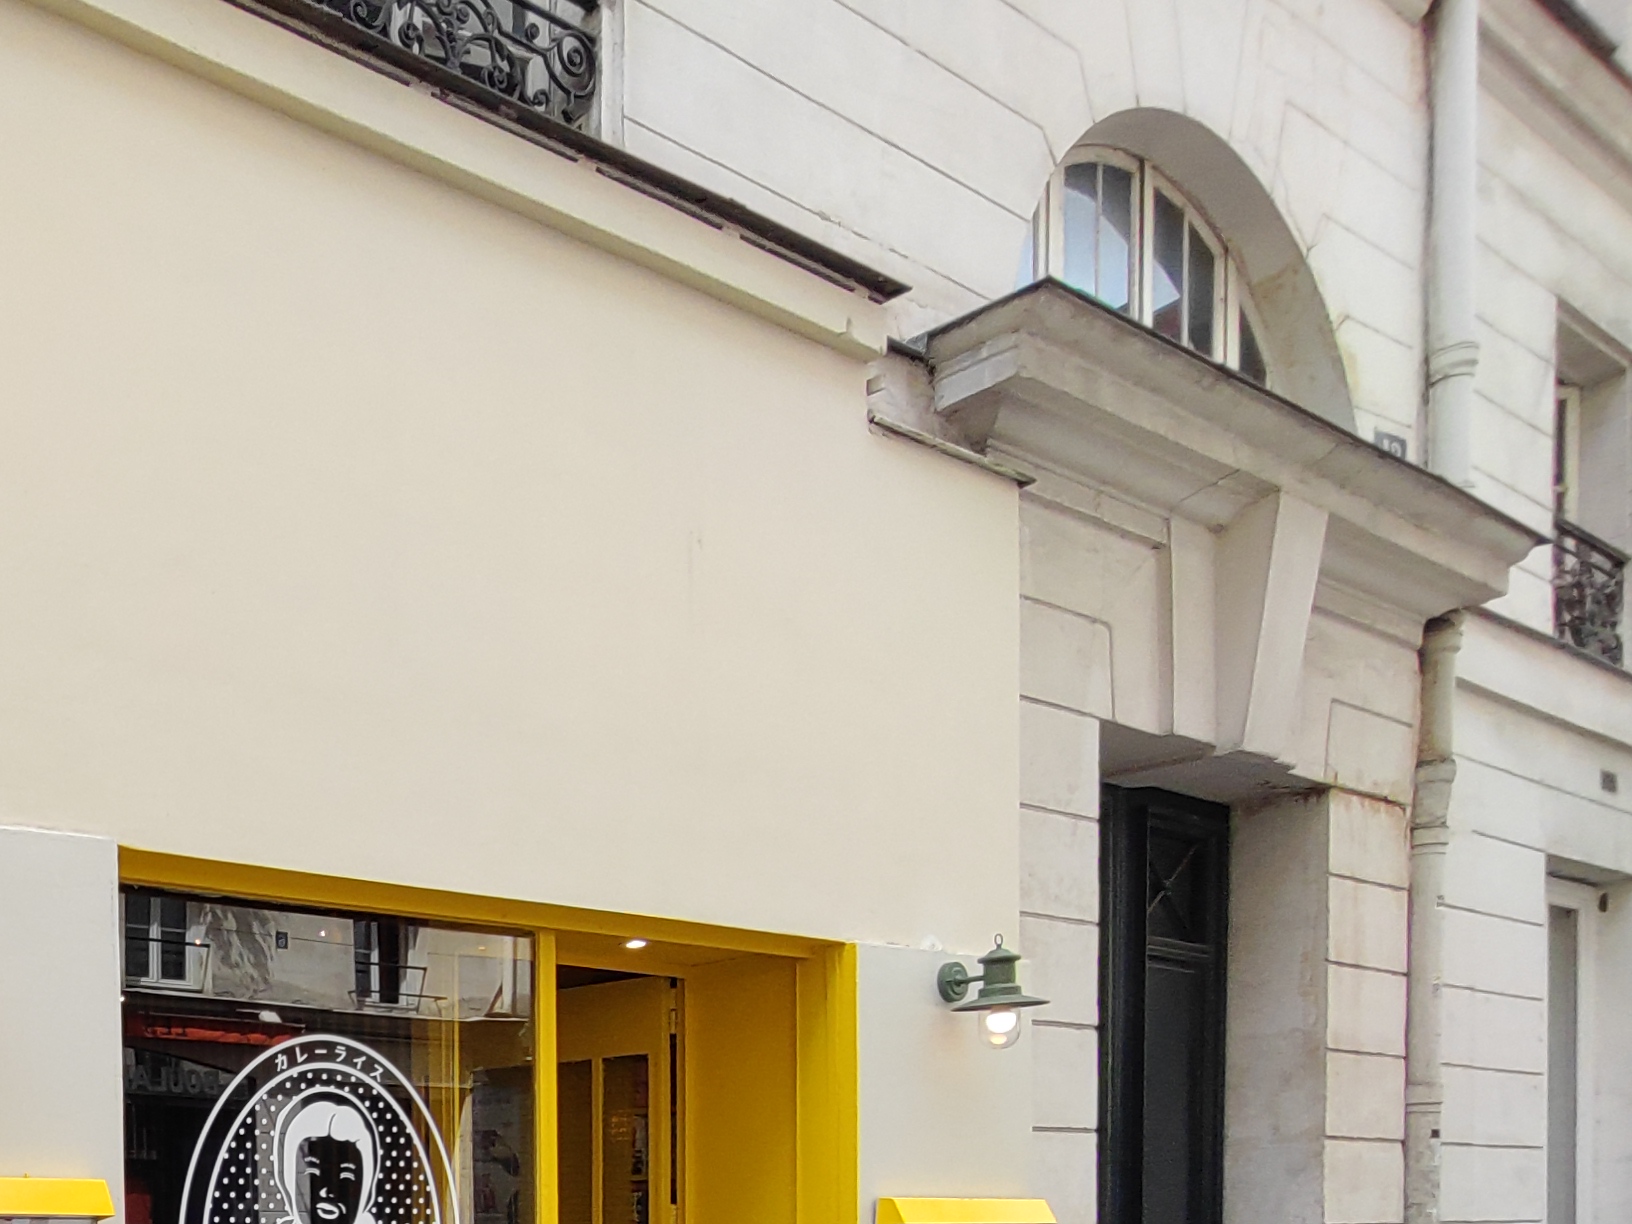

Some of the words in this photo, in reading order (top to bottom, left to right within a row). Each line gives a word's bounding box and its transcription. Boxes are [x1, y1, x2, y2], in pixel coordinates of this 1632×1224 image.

[274, 1045, 384, 1083] カレーライス
